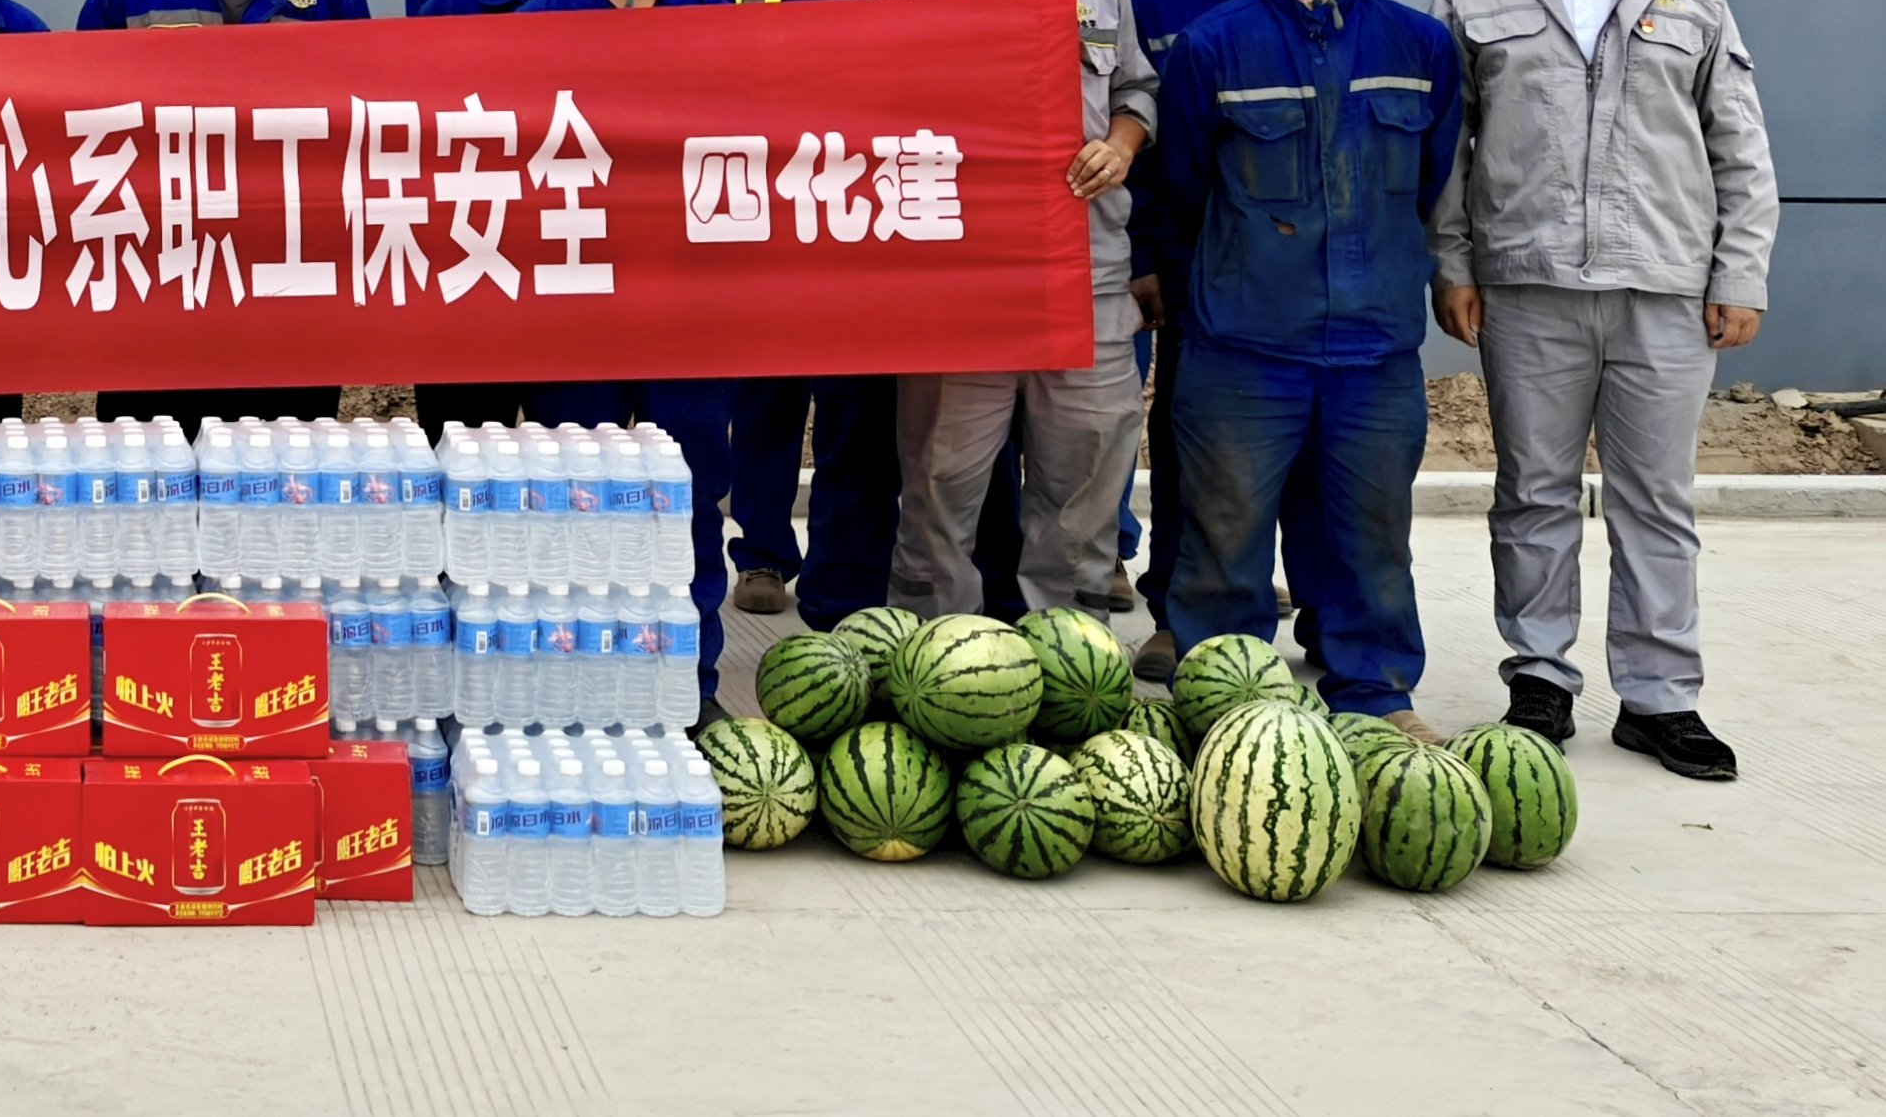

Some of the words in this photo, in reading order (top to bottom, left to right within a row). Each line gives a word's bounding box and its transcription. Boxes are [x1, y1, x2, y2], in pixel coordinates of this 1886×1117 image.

[682, 129, 964, 244] 四化建
[16, 674, 79, 718] 喝王老吉
[115, 676, 174, 718] 怕上火
[207, 652, 225, 713] 王老吉
[254, 675, 317, 719] 喝王老吉
[7, 838, 71, 884] 喝王老吉
[93, 840, 155, 886] 怕上火
[189, 818, 208, 880] 王老吉
[238, 840, 303, 886] 喝王老吉
[336, 818, 399, 862] 喝王老吉
